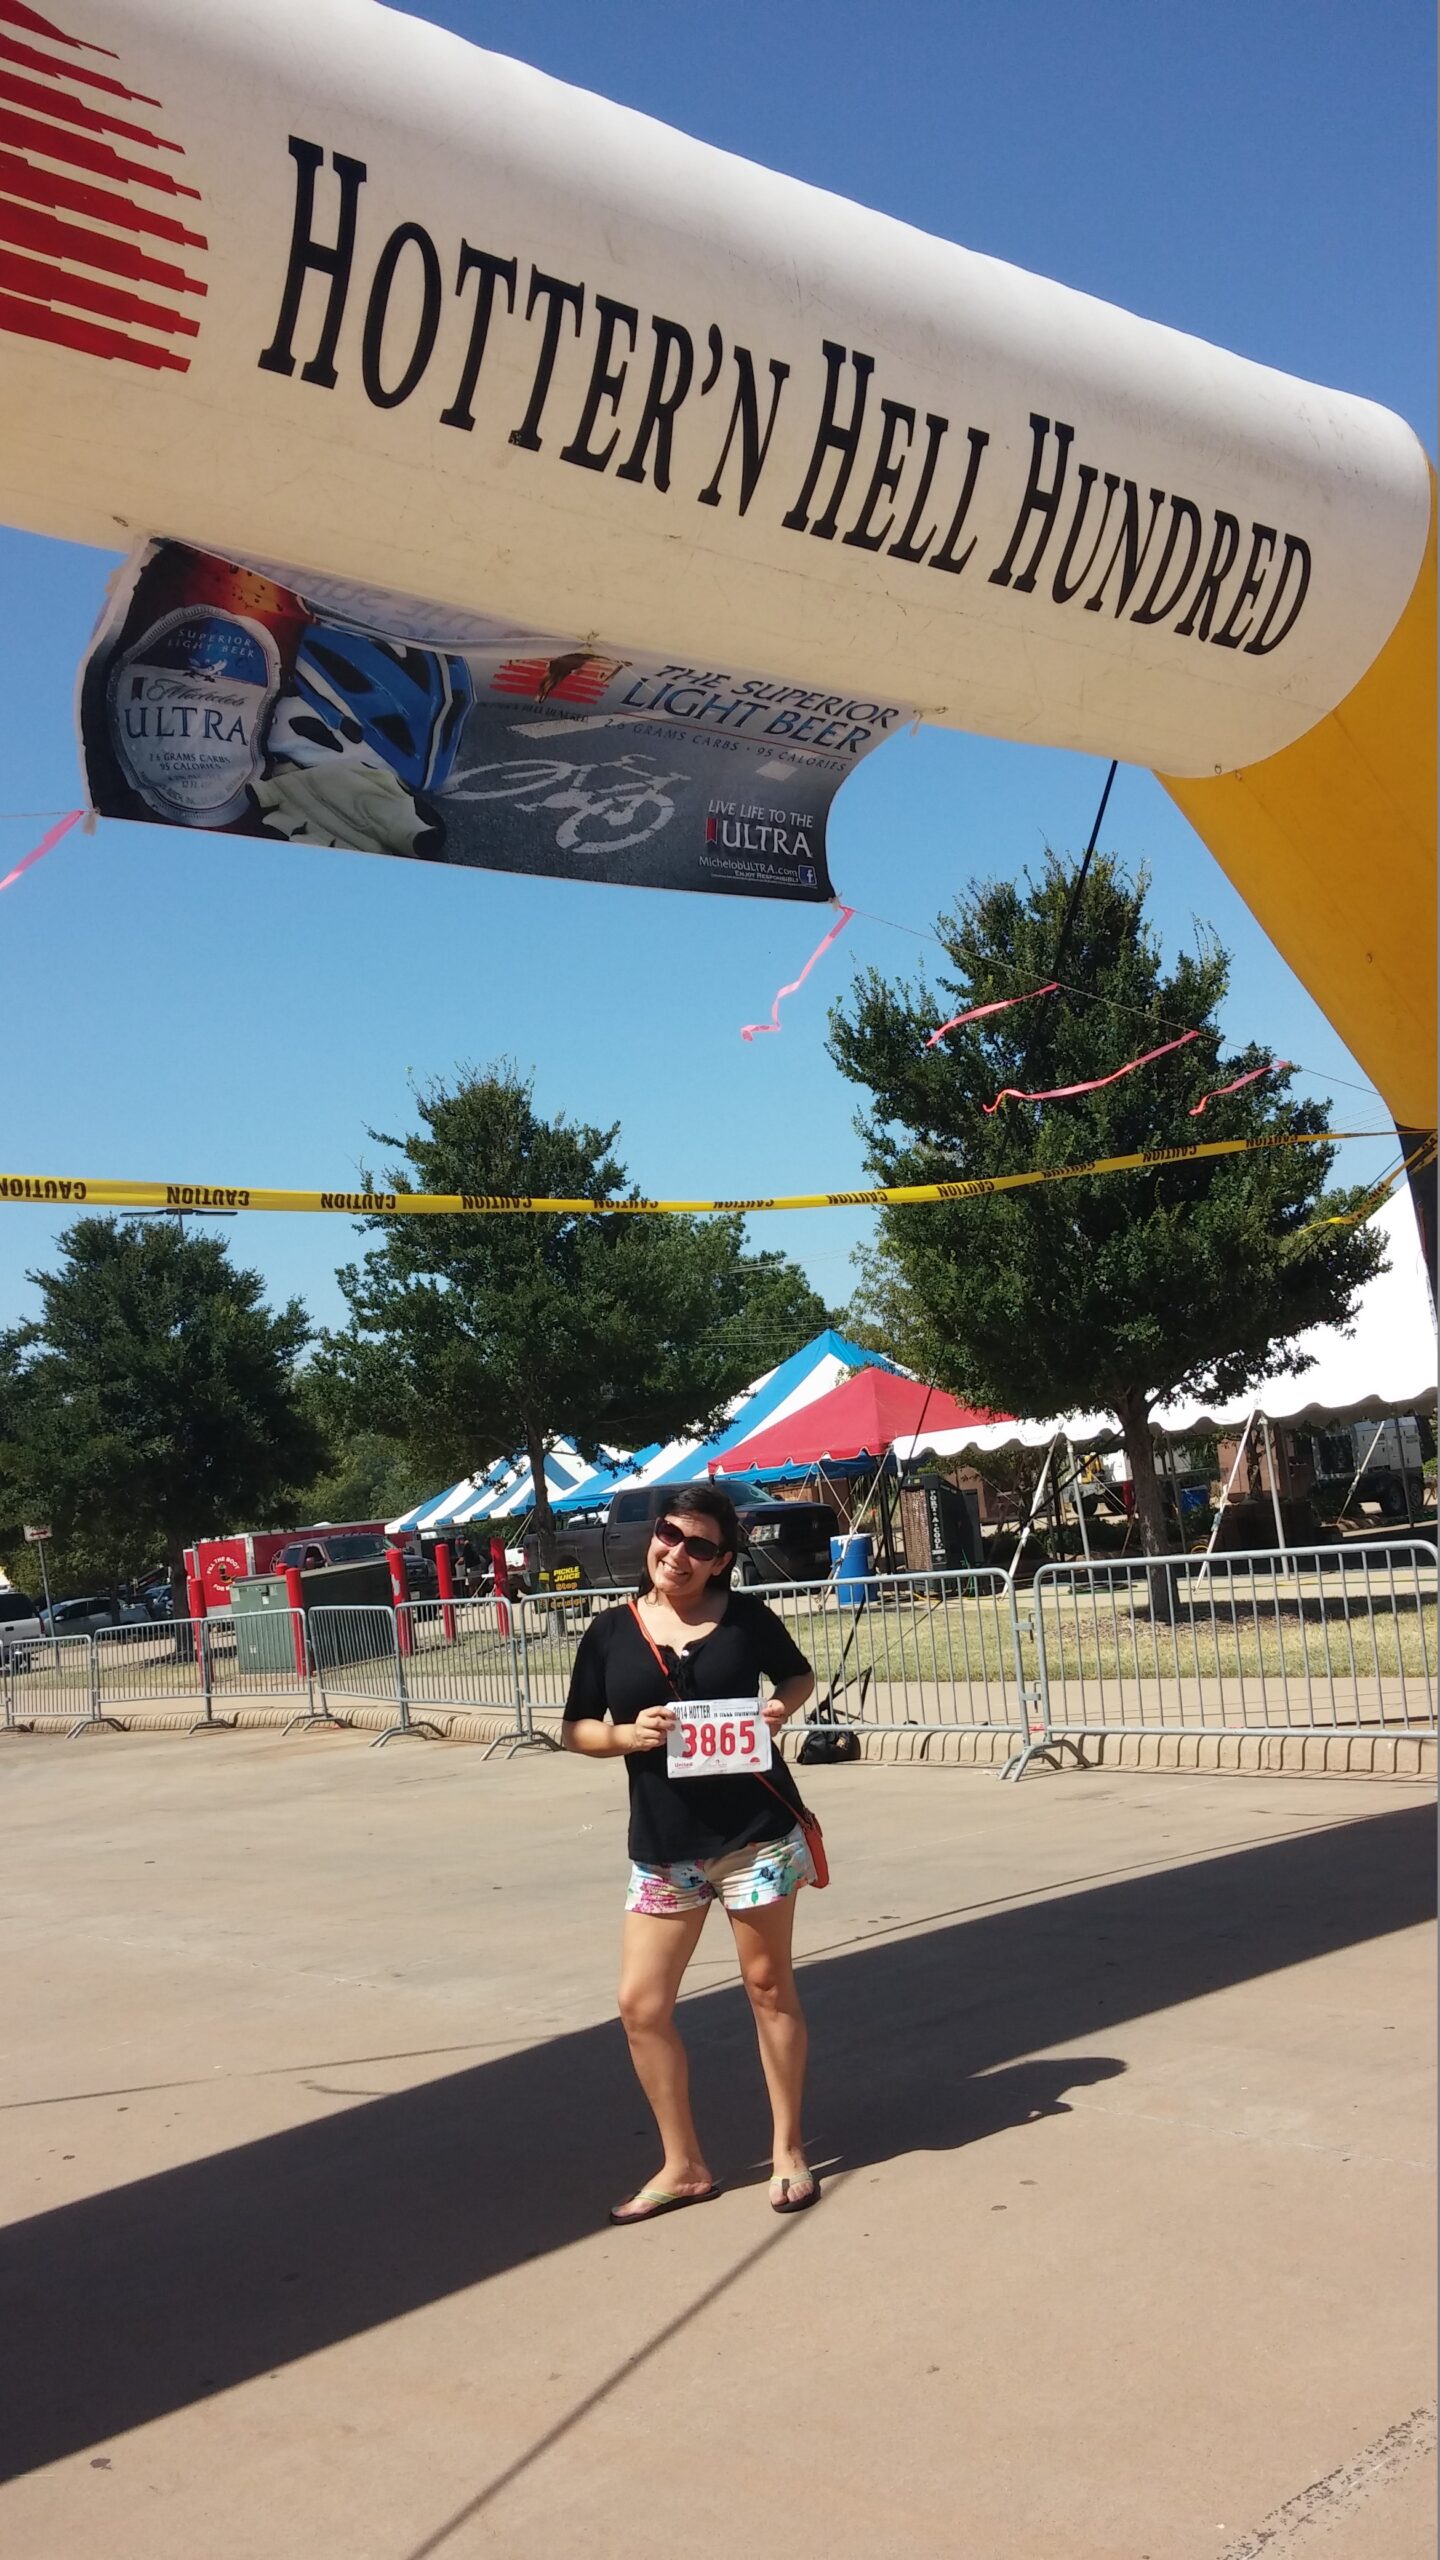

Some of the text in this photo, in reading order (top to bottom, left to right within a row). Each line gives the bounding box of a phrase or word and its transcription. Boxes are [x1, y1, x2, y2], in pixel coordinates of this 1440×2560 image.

[258, 135, 1311, 656] HOTTER'N HELL HUNDRED
[179, 629, 251, 647] SUPERIOR
[168, 639, 255, 658] LIGHT BEER
[655, 665, 899, 729] THE SUPERIOR
[619, 678, 871, 754] LIGHT BEER
[124, 706, 249, 746] ULTRA
[633, 723, 687, 742] GRAMS
[692, 734, 739, 751] CARBS
[778, 751, 848, 773] CALORIES
[164, 752, 196, 762] GRAMS
[200, 753, 231, 764] CARBS
[173, 761, 222, 772] CALORIES
[708, 800, 814, 829] LIVE LIFE TO THE
[722, 819, 813, 859] ULTRA
[699, 855, 798, 877] MichelobULTRA.com
[1142, 1145, 1198, 1163] CAUTION
[0, 1178, 87, 1199] CAUTION
[166, 1186, 250, 1206] CAUTION
[828, 1190, 889, 1205] CAUTION
[936, 1180, 996, 1198] CAUTION
[320, 1193, 397, 1209] CAUTION
[462, 1195, 533, 1209] CAUTION
[207, 1556, 240, 1574] FILL THE BOOT
[554, 1566, 580, 1576] PICKLE
[554, 1572, 581, 1582] JUICE
[673, 1706, 688, 1720] 2014
[689, 1705, 711, 1720] HOTTER
[681, 1720, 755, 1758] 3865
